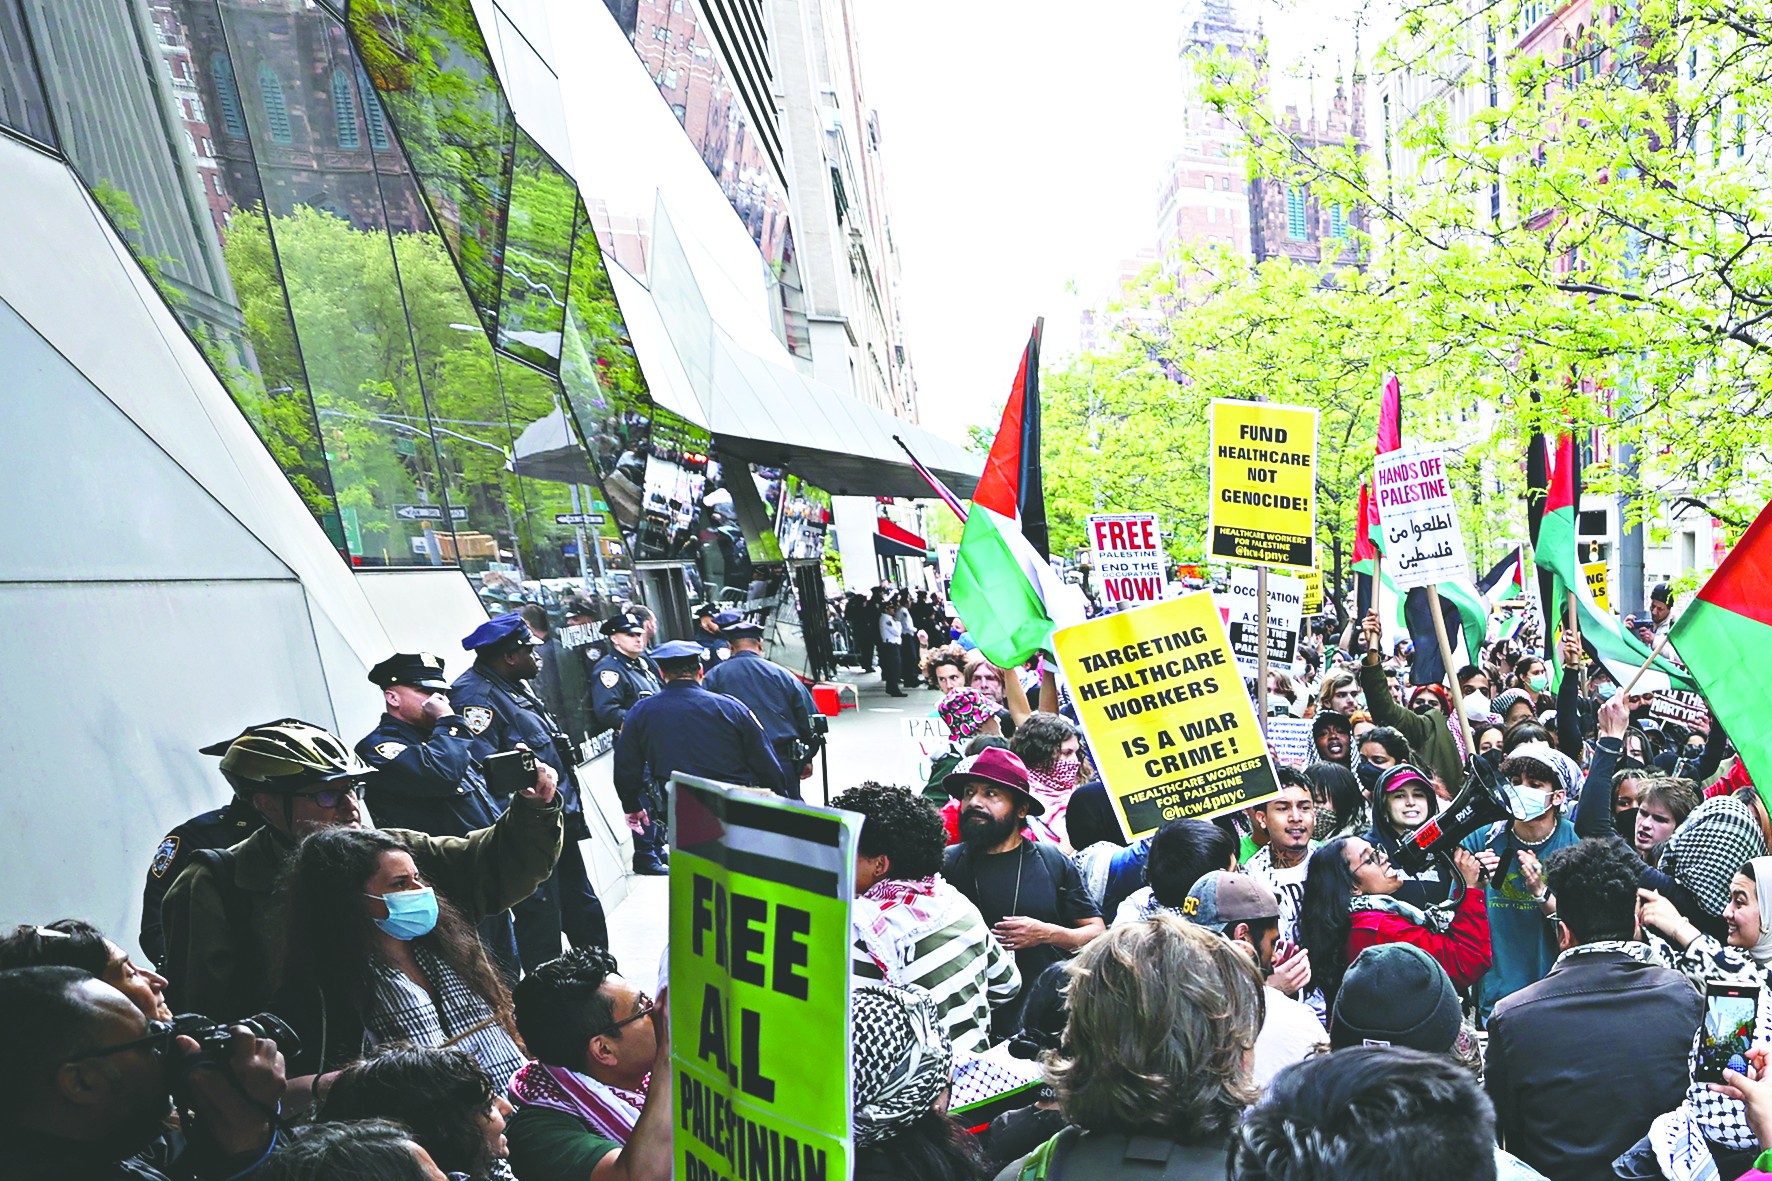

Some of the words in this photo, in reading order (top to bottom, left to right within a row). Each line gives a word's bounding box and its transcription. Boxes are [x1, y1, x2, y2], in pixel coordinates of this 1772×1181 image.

[1240, 424, 1287, 443] FUND
[1218, 445, 1310, 467] HEALTHCARE
[1247, 467, 1277, 483] NOT
[1379, 462, 1418, 486] HANDS
[1420, 458, 1441, 477] OFF
[1222, 489, 1307, 511] GENOCIDE!
[1381, 479, 1447, 507] PALESTINE
[1095, 521, 1156, 550] FREE
[1220, 527, 1265, 540] HEALTHCARE
[1267, 533, 1307, 544] WORKERS
[1390, 527, 1408, 543] من
[1410, 513, 1452, 542] اطلعوا
[1252, 540, 1291, 550] PALESTINE
[1399, 541, 1453, 569] فلسطين
[1105, 577, 1163, 601] NOW!
[1234, 585, 1299, 604] OCCPATION
[1242, 634, 1274, 648] BROX
[1276, 641, 1286, 649] TO
[1272, 628, 1287, 639] THE
[1079, 626, 1208, 674] TARGETING
[1235, 643, 1287, 658] PALETINE!
[1079, 648, 1226, 701] HEALTHCARE
[1103, 677, 1219, 721] WORKERS
[1651, 699, 1705, 721] MARTYRS
[1122, 737, 1149, 758] IS
[1158, 731, 1176, 749] A
[1179, 712, 1238, 742] WAR
[1129, 775, 1204, 805] HEALTHCARE
[1206, 758, 1261, 782] WORKERS
[1156, 794, 1180, 809] FOR
[1184, 776, 1243, 799] PALESTINE
[1162, 789, 1246, 821] @hcw4pnyc
[1455, 805, 1474, 822] PYLE
